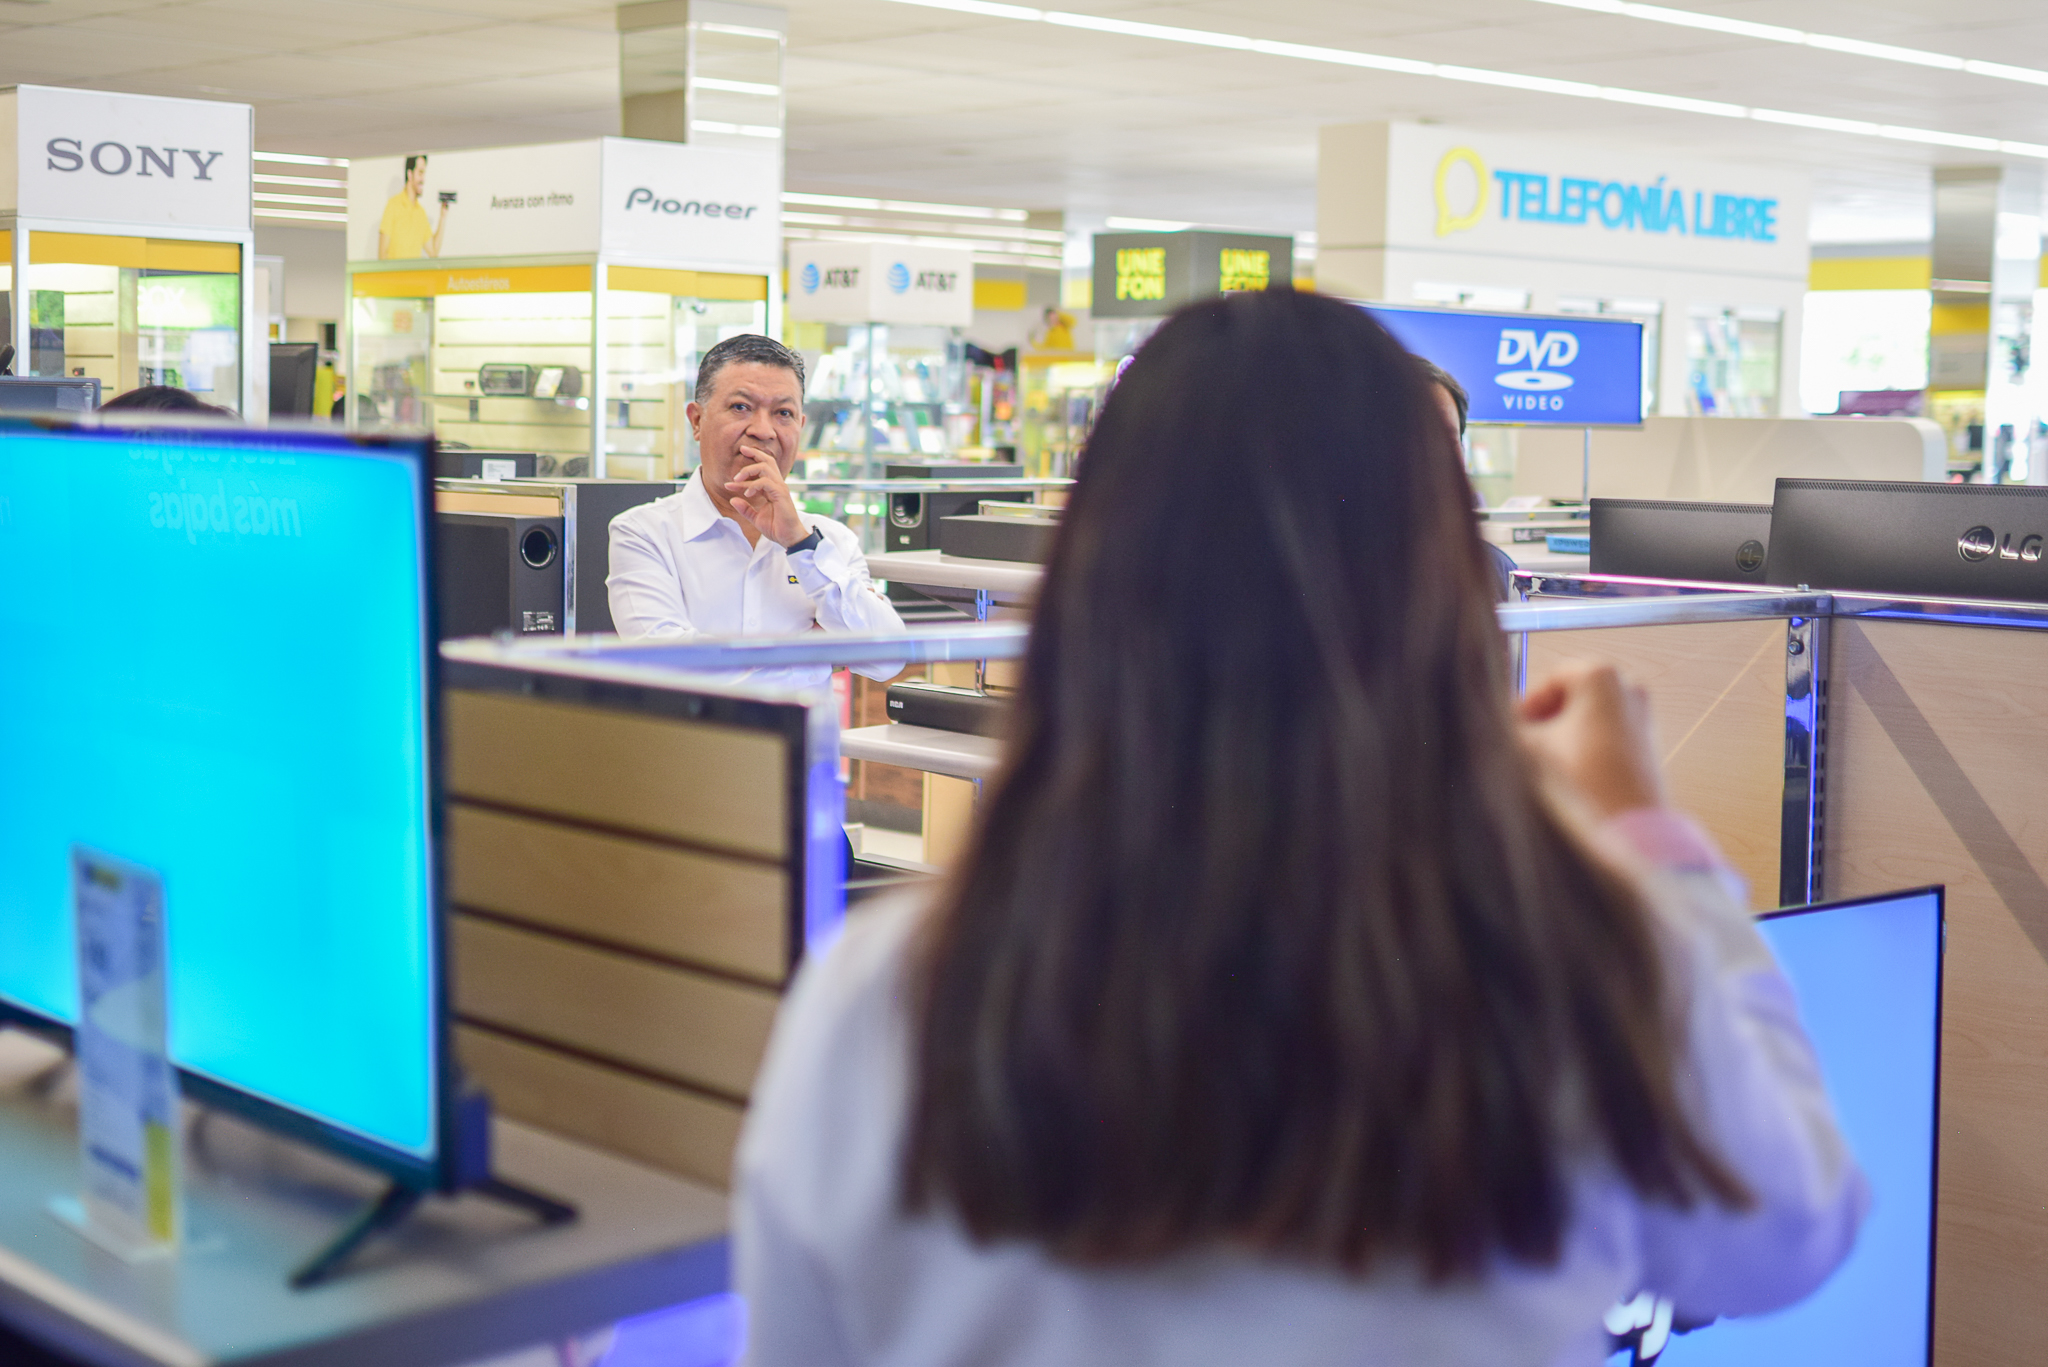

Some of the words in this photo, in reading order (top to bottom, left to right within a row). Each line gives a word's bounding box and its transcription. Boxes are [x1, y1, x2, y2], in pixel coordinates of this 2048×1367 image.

[46, 137, 224, 181] SONY
[490, 195, 525, 210] Avanza
[527, 195, 545, 208] con
[547, 191, 574, 206] ritmo
[625, 187, 758, 220] Pioneer
[1494, 170, 1688, 236] TELEFONÍA
[1694, 190, 1778, 243] LIBRE
[1116, 248, 1166, 276] UNE
[1219, 248, 1271, 277] UNE
[447, 274, 511, 292] Autoestéreos
[824, 267, 860, 289] AT&T
[916, 271, 958, 292] AT&T
[1116, 275, 1166, 301] FON
[1497, 329, 1580, 372] DVD
[1502, 395, 1564, 411] VIDEO
[2000, 533, 2044, 561] LG
[890, 700, 904, 709] RCA
